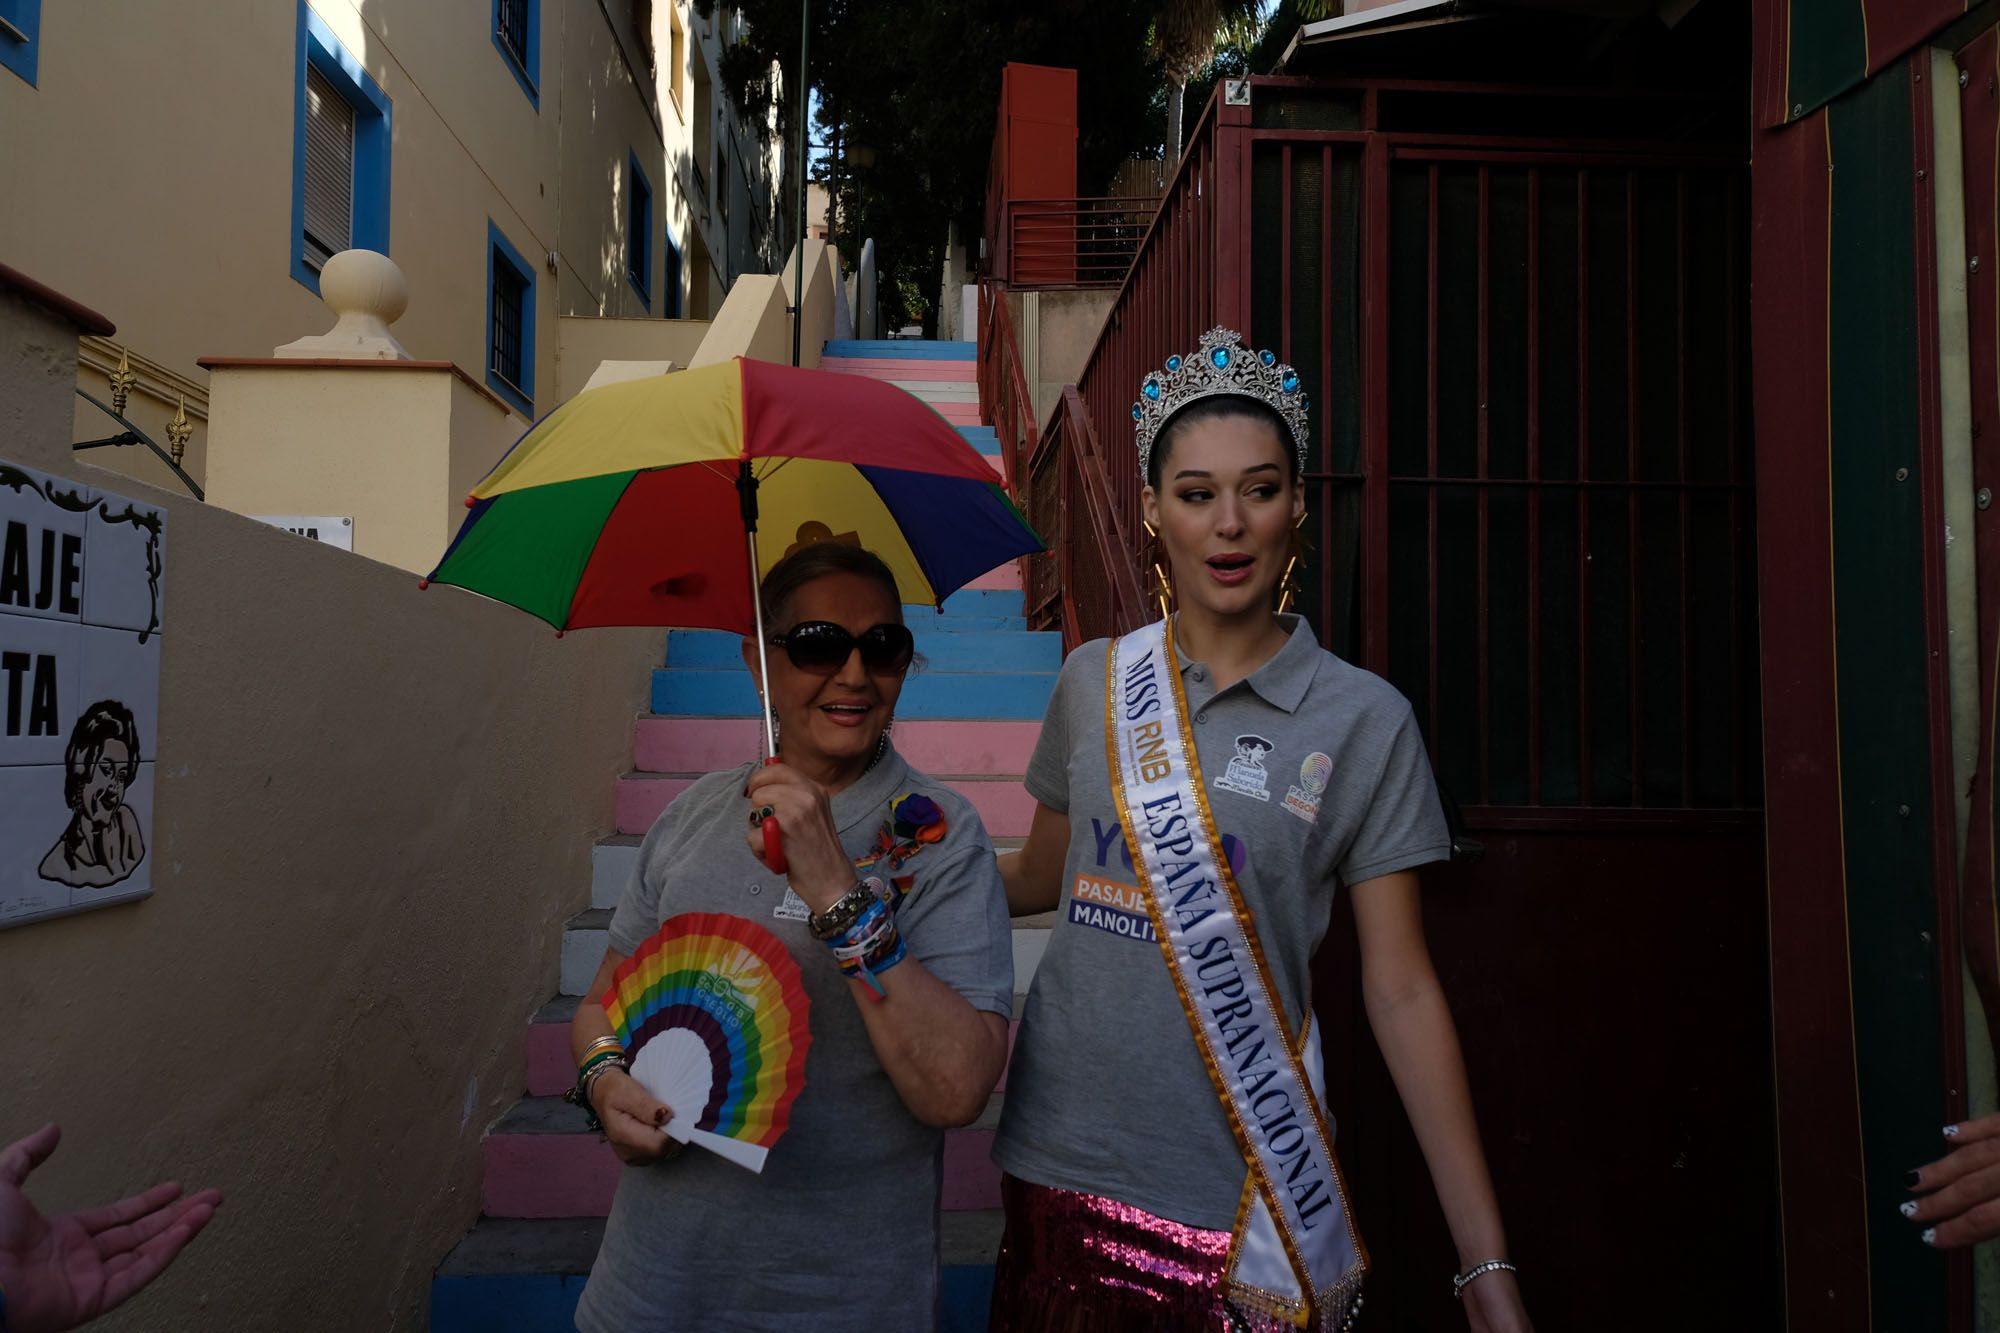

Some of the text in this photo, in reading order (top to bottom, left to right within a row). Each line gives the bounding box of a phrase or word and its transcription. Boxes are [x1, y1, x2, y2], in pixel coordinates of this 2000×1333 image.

[2, 652, 58, 736] TA
[1077, 879, 1147, 912] PASAJE
[1125, 647, 1333, 1232] MISS RNB ESPAÑA SUPRANACIONAL
